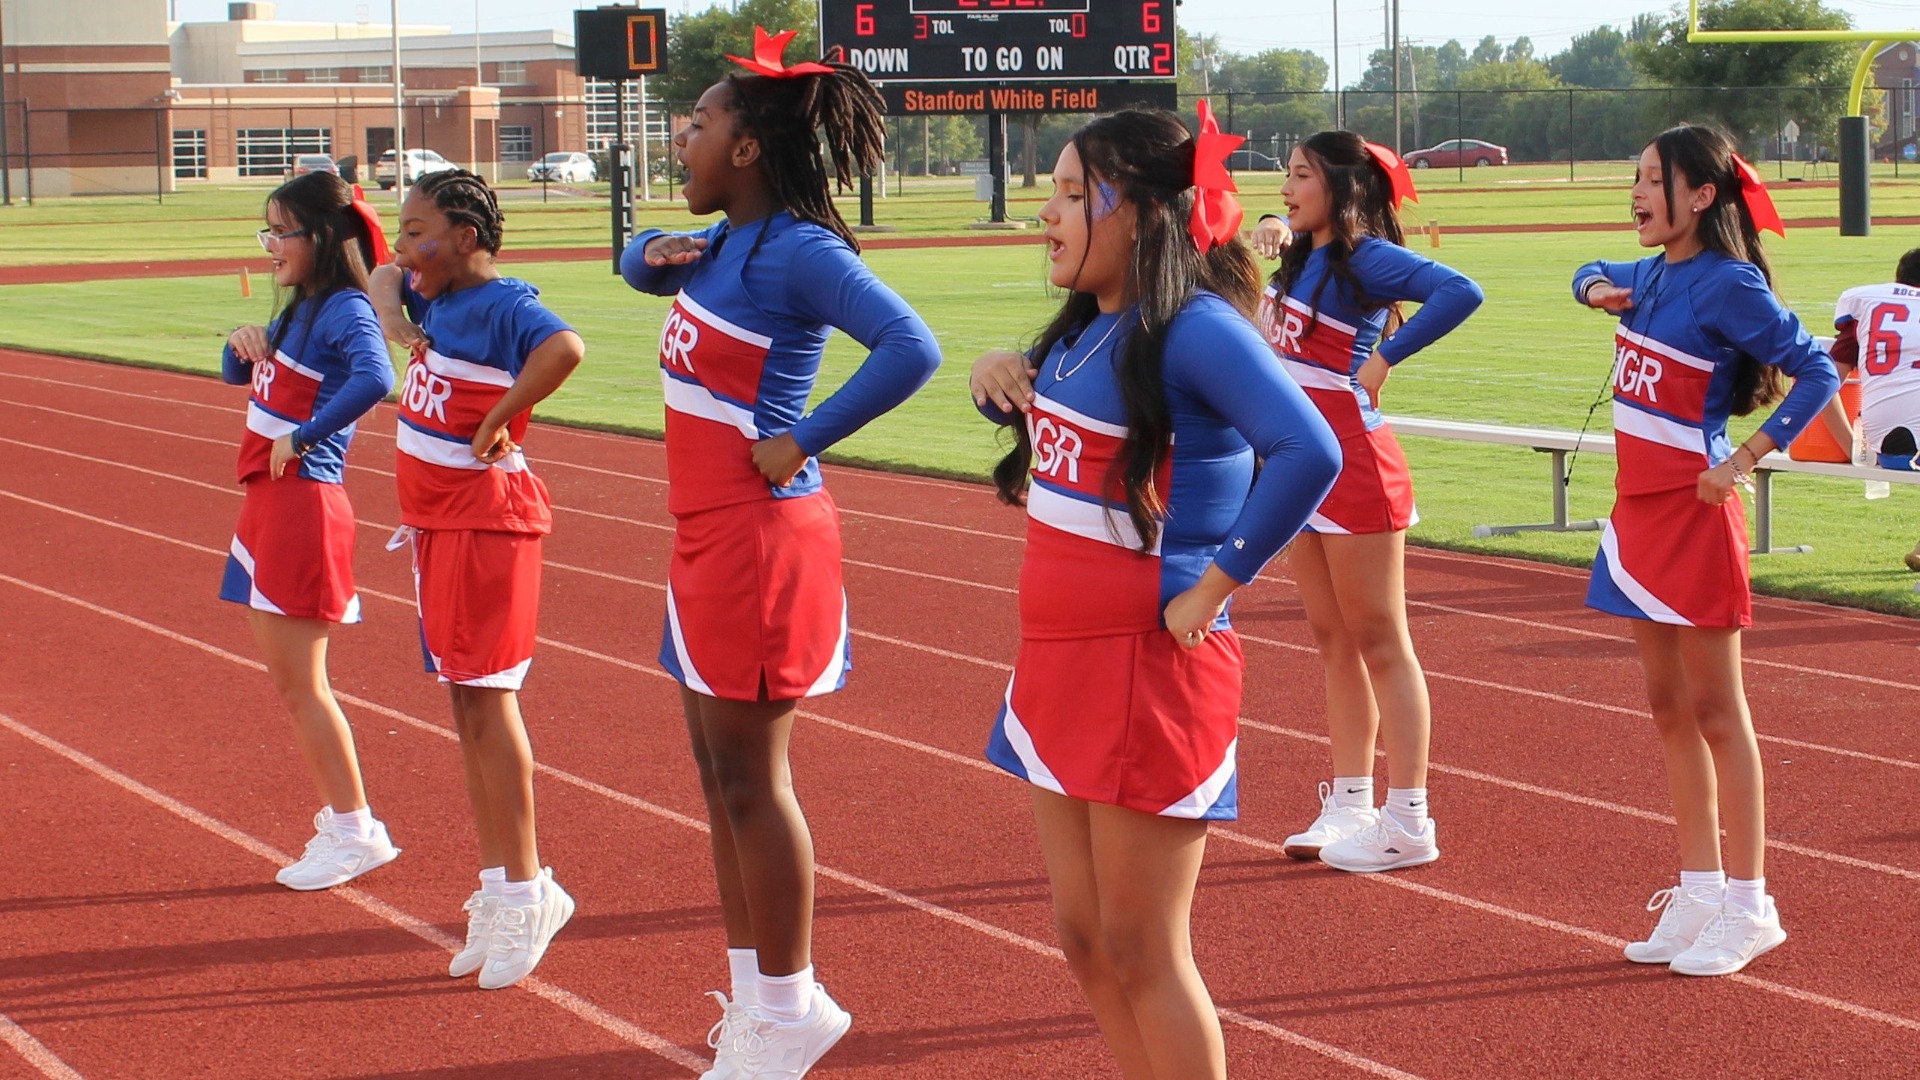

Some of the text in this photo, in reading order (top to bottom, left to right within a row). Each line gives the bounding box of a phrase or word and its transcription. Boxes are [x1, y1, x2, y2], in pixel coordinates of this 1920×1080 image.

[856, 4, 875, 36] 6
[914, 15, 928, 39] 3
[931, 19, 954, 34] TOL
[1048, 19, 1071, 34] TOL
[1072, 13, 1086, 38] 0
[1142, 2, 1160, 33] 6
[850, 48, 908, 73] DOWN
[961, 46, 1063, 72] TO GO ON
[1114, 45, 1150, 73] QTR
[1153, 43, 1170, 74] 2
[905, 88, 1098, 112] Stanford White Field
